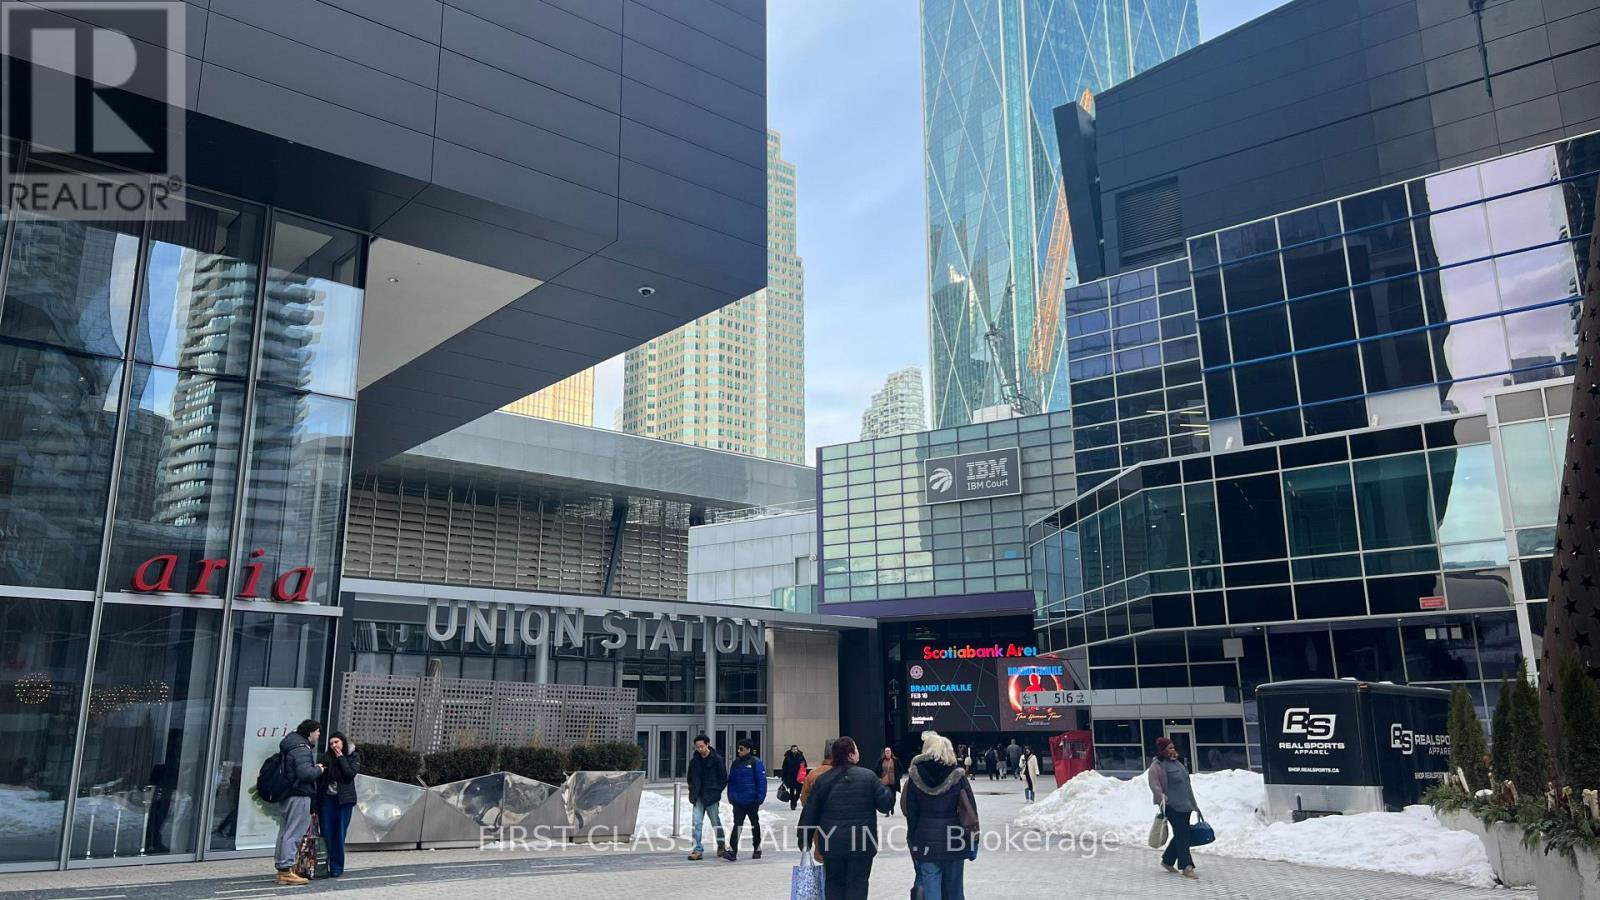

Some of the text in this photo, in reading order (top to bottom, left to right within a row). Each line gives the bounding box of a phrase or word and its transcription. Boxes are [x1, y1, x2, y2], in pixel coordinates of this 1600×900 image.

[966, 458, 1008, 480] IBM
[967, 479, 1009, 491] IBM Court
[131, 549, 315, 602] aria
[426, 599, 766, 655] UNION STATION
[923, 644, 1004, 659] Scotiabank
[911, 683, 972, 692] BRANDI CARLILE
[256, 723, 290, 738] ari
[1279, 742, 1345, 750] REALSPORTS
[1414, 734, 1451, 746] REALSPO
[1428, 747, 1451, 756] APPARE
